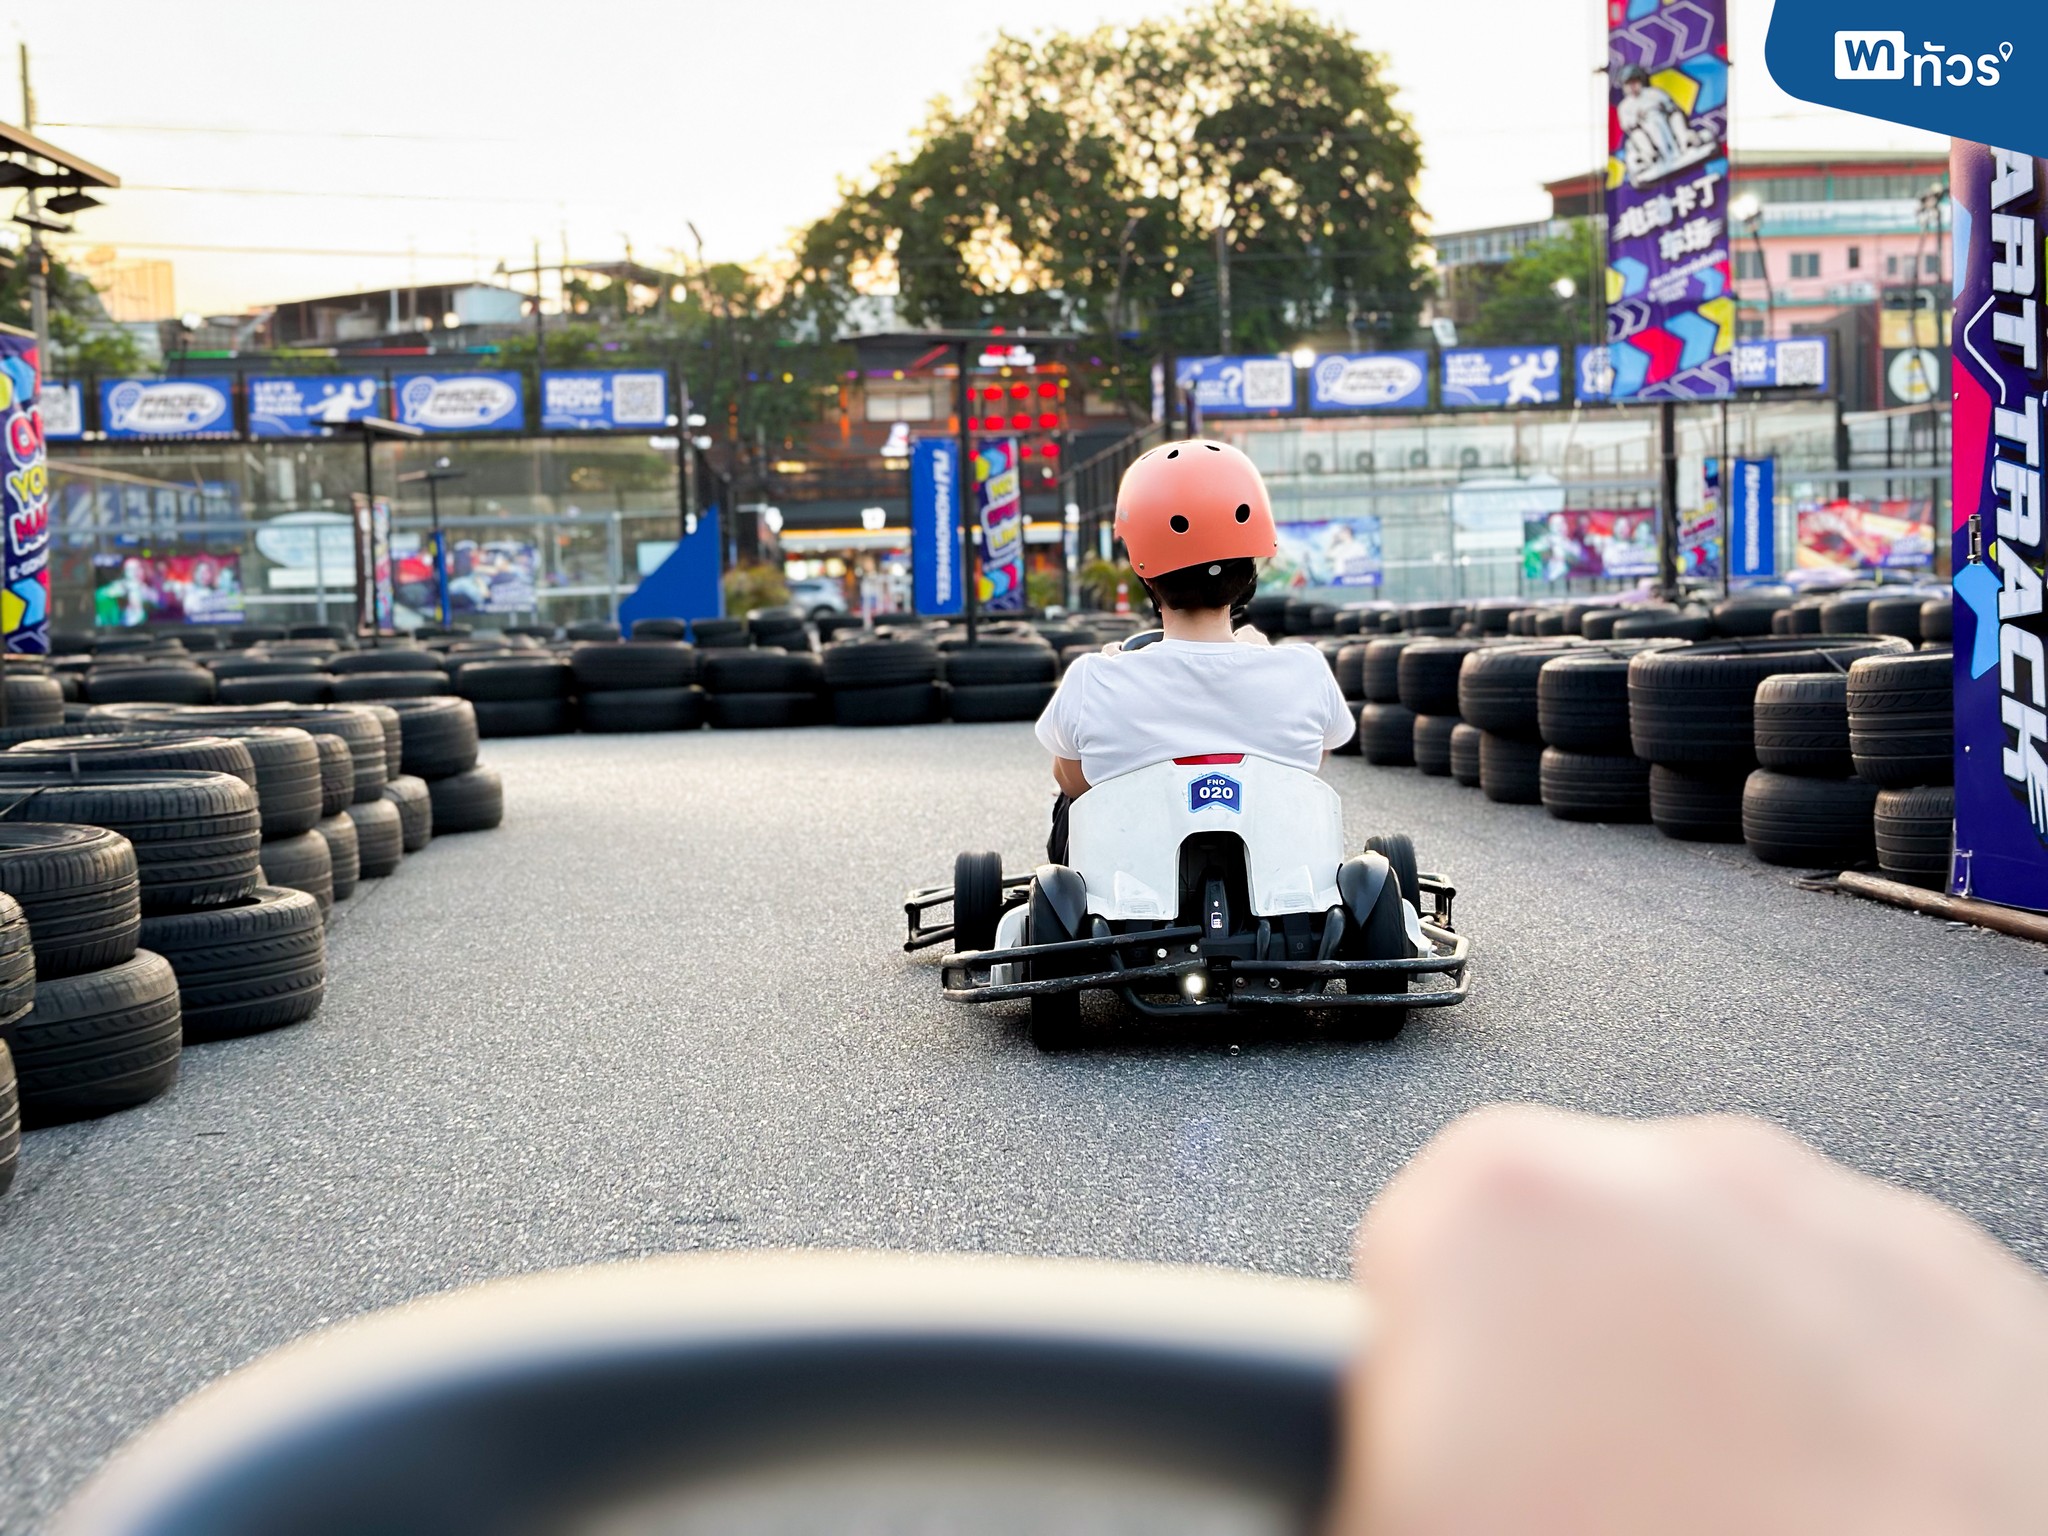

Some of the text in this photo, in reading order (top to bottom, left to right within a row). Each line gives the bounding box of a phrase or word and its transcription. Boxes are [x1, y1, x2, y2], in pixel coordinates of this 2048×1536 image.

[142, 394, 211, 409] PADEL
[436, 388, 501, 401] PADEL
[1989, 145, 2048, 785] ART TRACK
[11, 467, 48, 503] YO
[1200, 787, 1233, 799] 020
